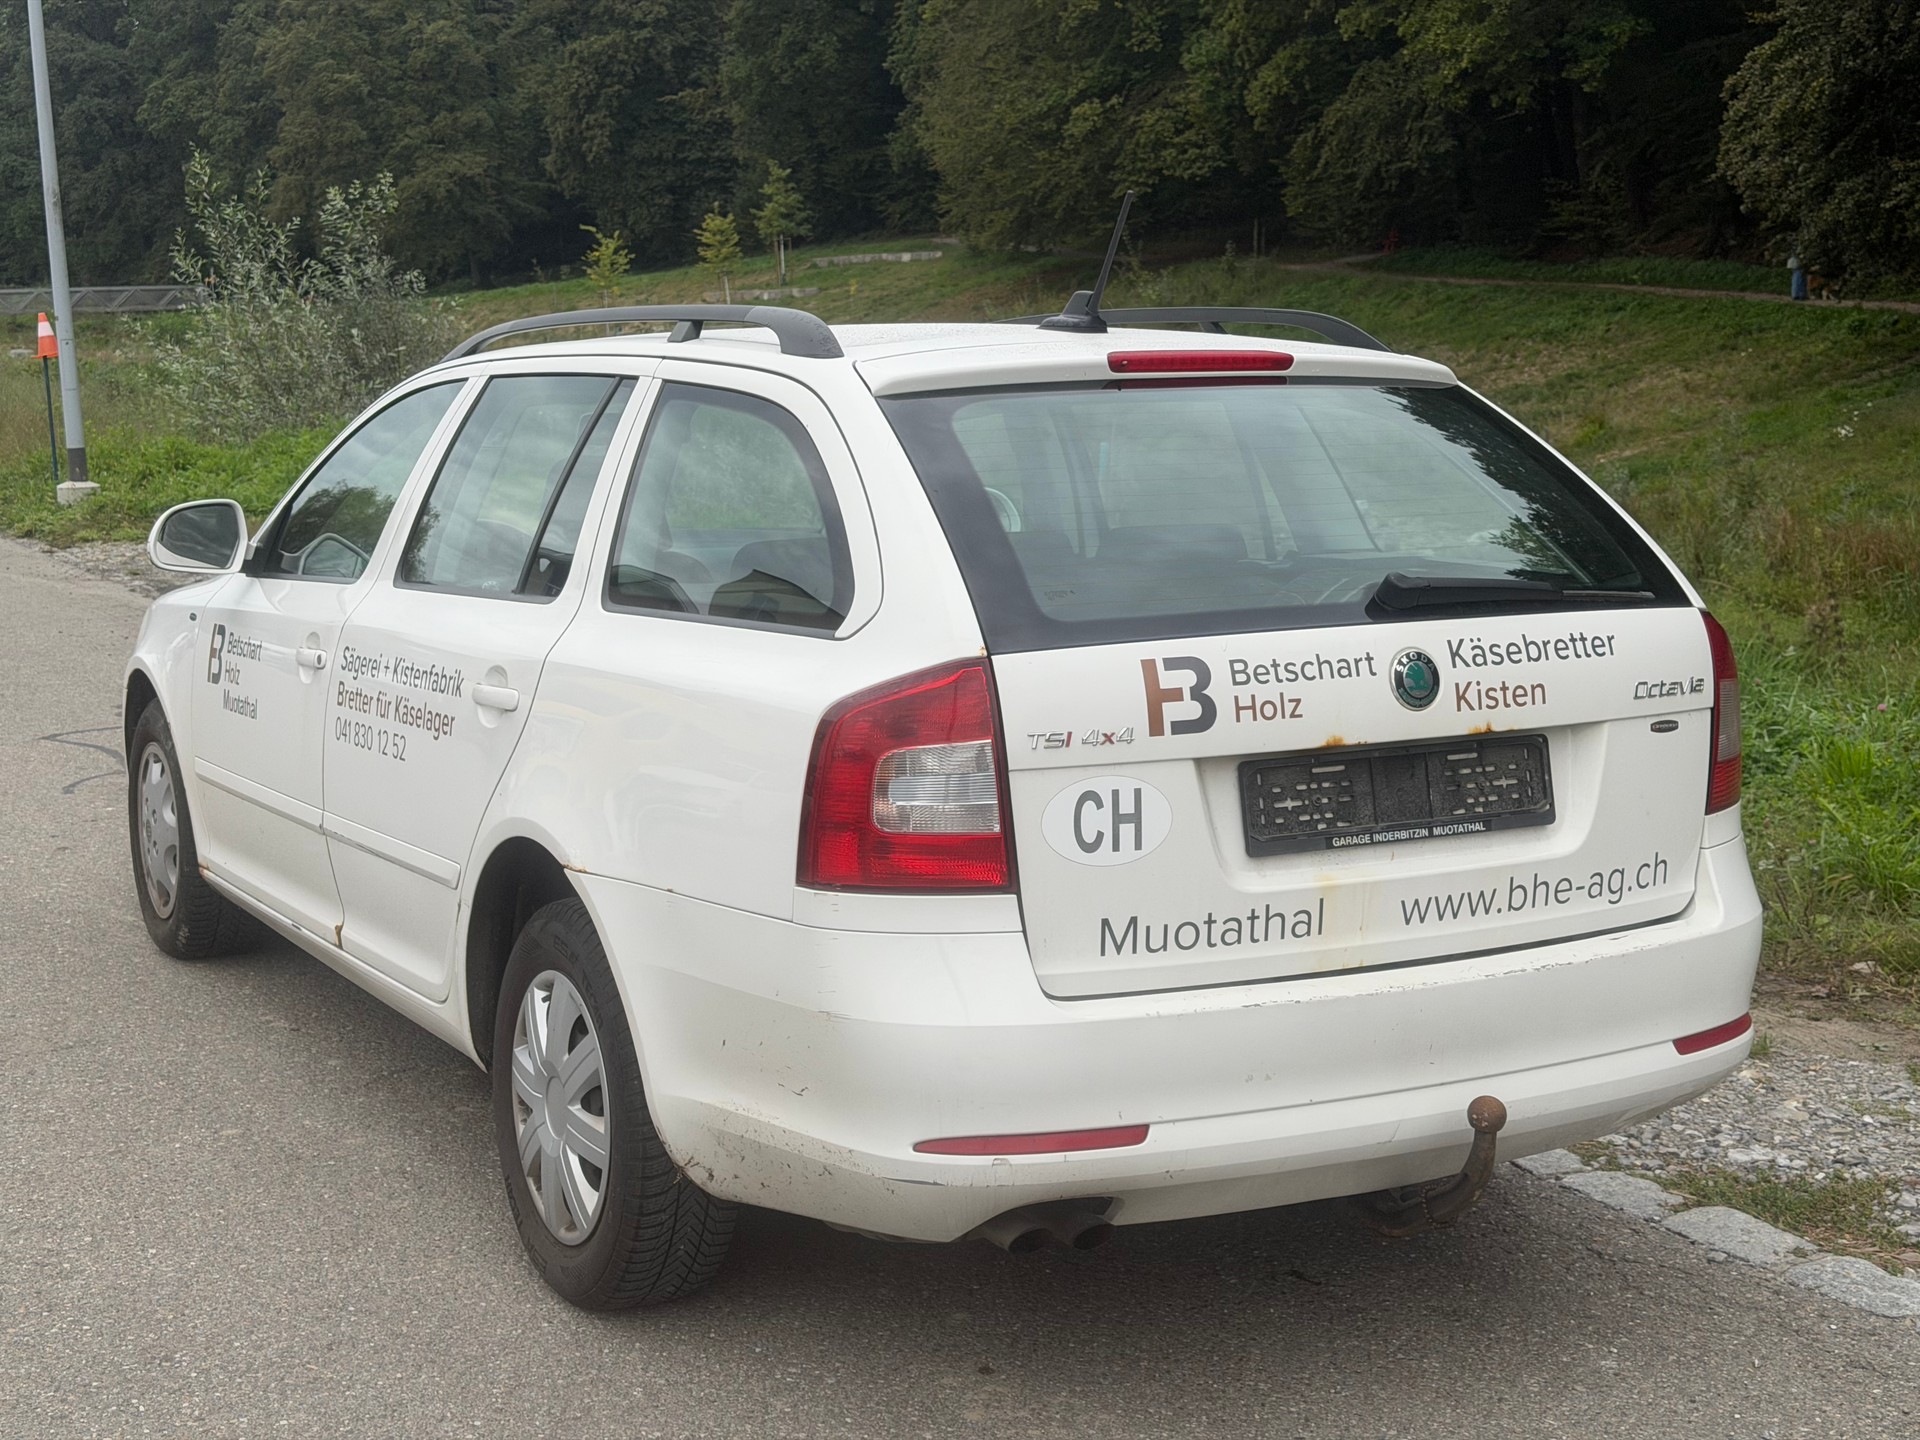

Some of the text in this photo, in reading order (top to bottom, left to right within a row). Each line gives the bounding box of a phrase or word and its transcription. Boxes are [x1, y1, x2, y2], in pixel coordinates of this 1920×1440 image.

[227, 632, 262, 661] Betschart
[1446, 632, 1616, 669] Käsebretter
[224, 660, 240, 685] Holz
[341, 646, 464, 698] Sägerei + Kistenfabrik
[1228, 652, 1378, 687] Betschart
[223, 688, 257, 720] Muotathal
[1454, 682, 1547, 713] Kisten
[1633, 676, 1704, 700] Octavia
[337, 680, 455, 741] Bretter für Käselager
[1233, 692, 1304, 723] Holz
[353, 721, 373, 751] 830
[378, 728, 388, 756] 12
[392, 732, 406, 762] 52
[1027, 726, 1135, 749] TSI 4x4
[1073, 787, 1143, 854] CH
[1332, 821, 1487, 847] GARAGE INDERBITZIN MUOTATHAL
[1400, 851, 1669, 926] www.bhe-ag.ch
[1100, 897, 1324, 957] Muotathal
